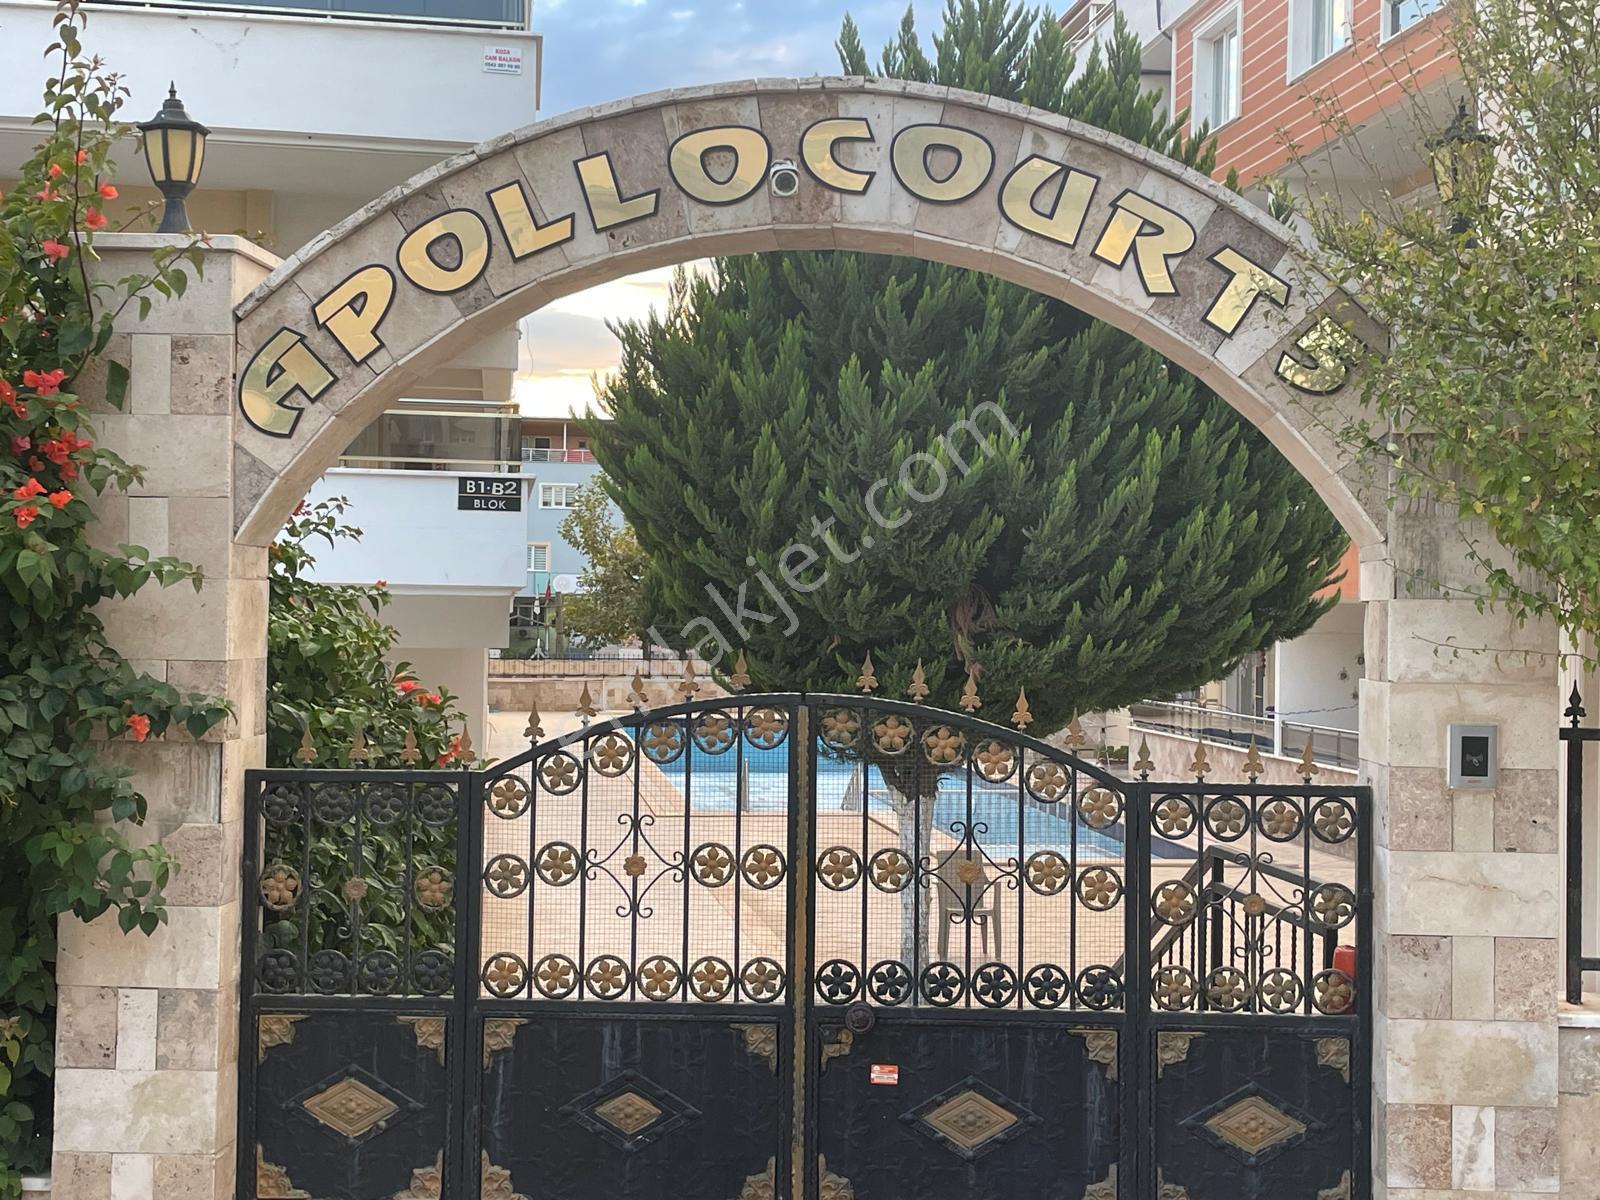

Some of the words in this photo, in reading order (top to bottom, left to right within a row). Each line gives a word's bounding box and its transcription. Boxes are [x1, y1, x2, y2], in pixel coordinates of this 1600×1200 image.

[239, 125, 771, 438] APOLLO
[799, 117, 1362, 396] COURTS
[473, 499, 507, 510] BLOK
